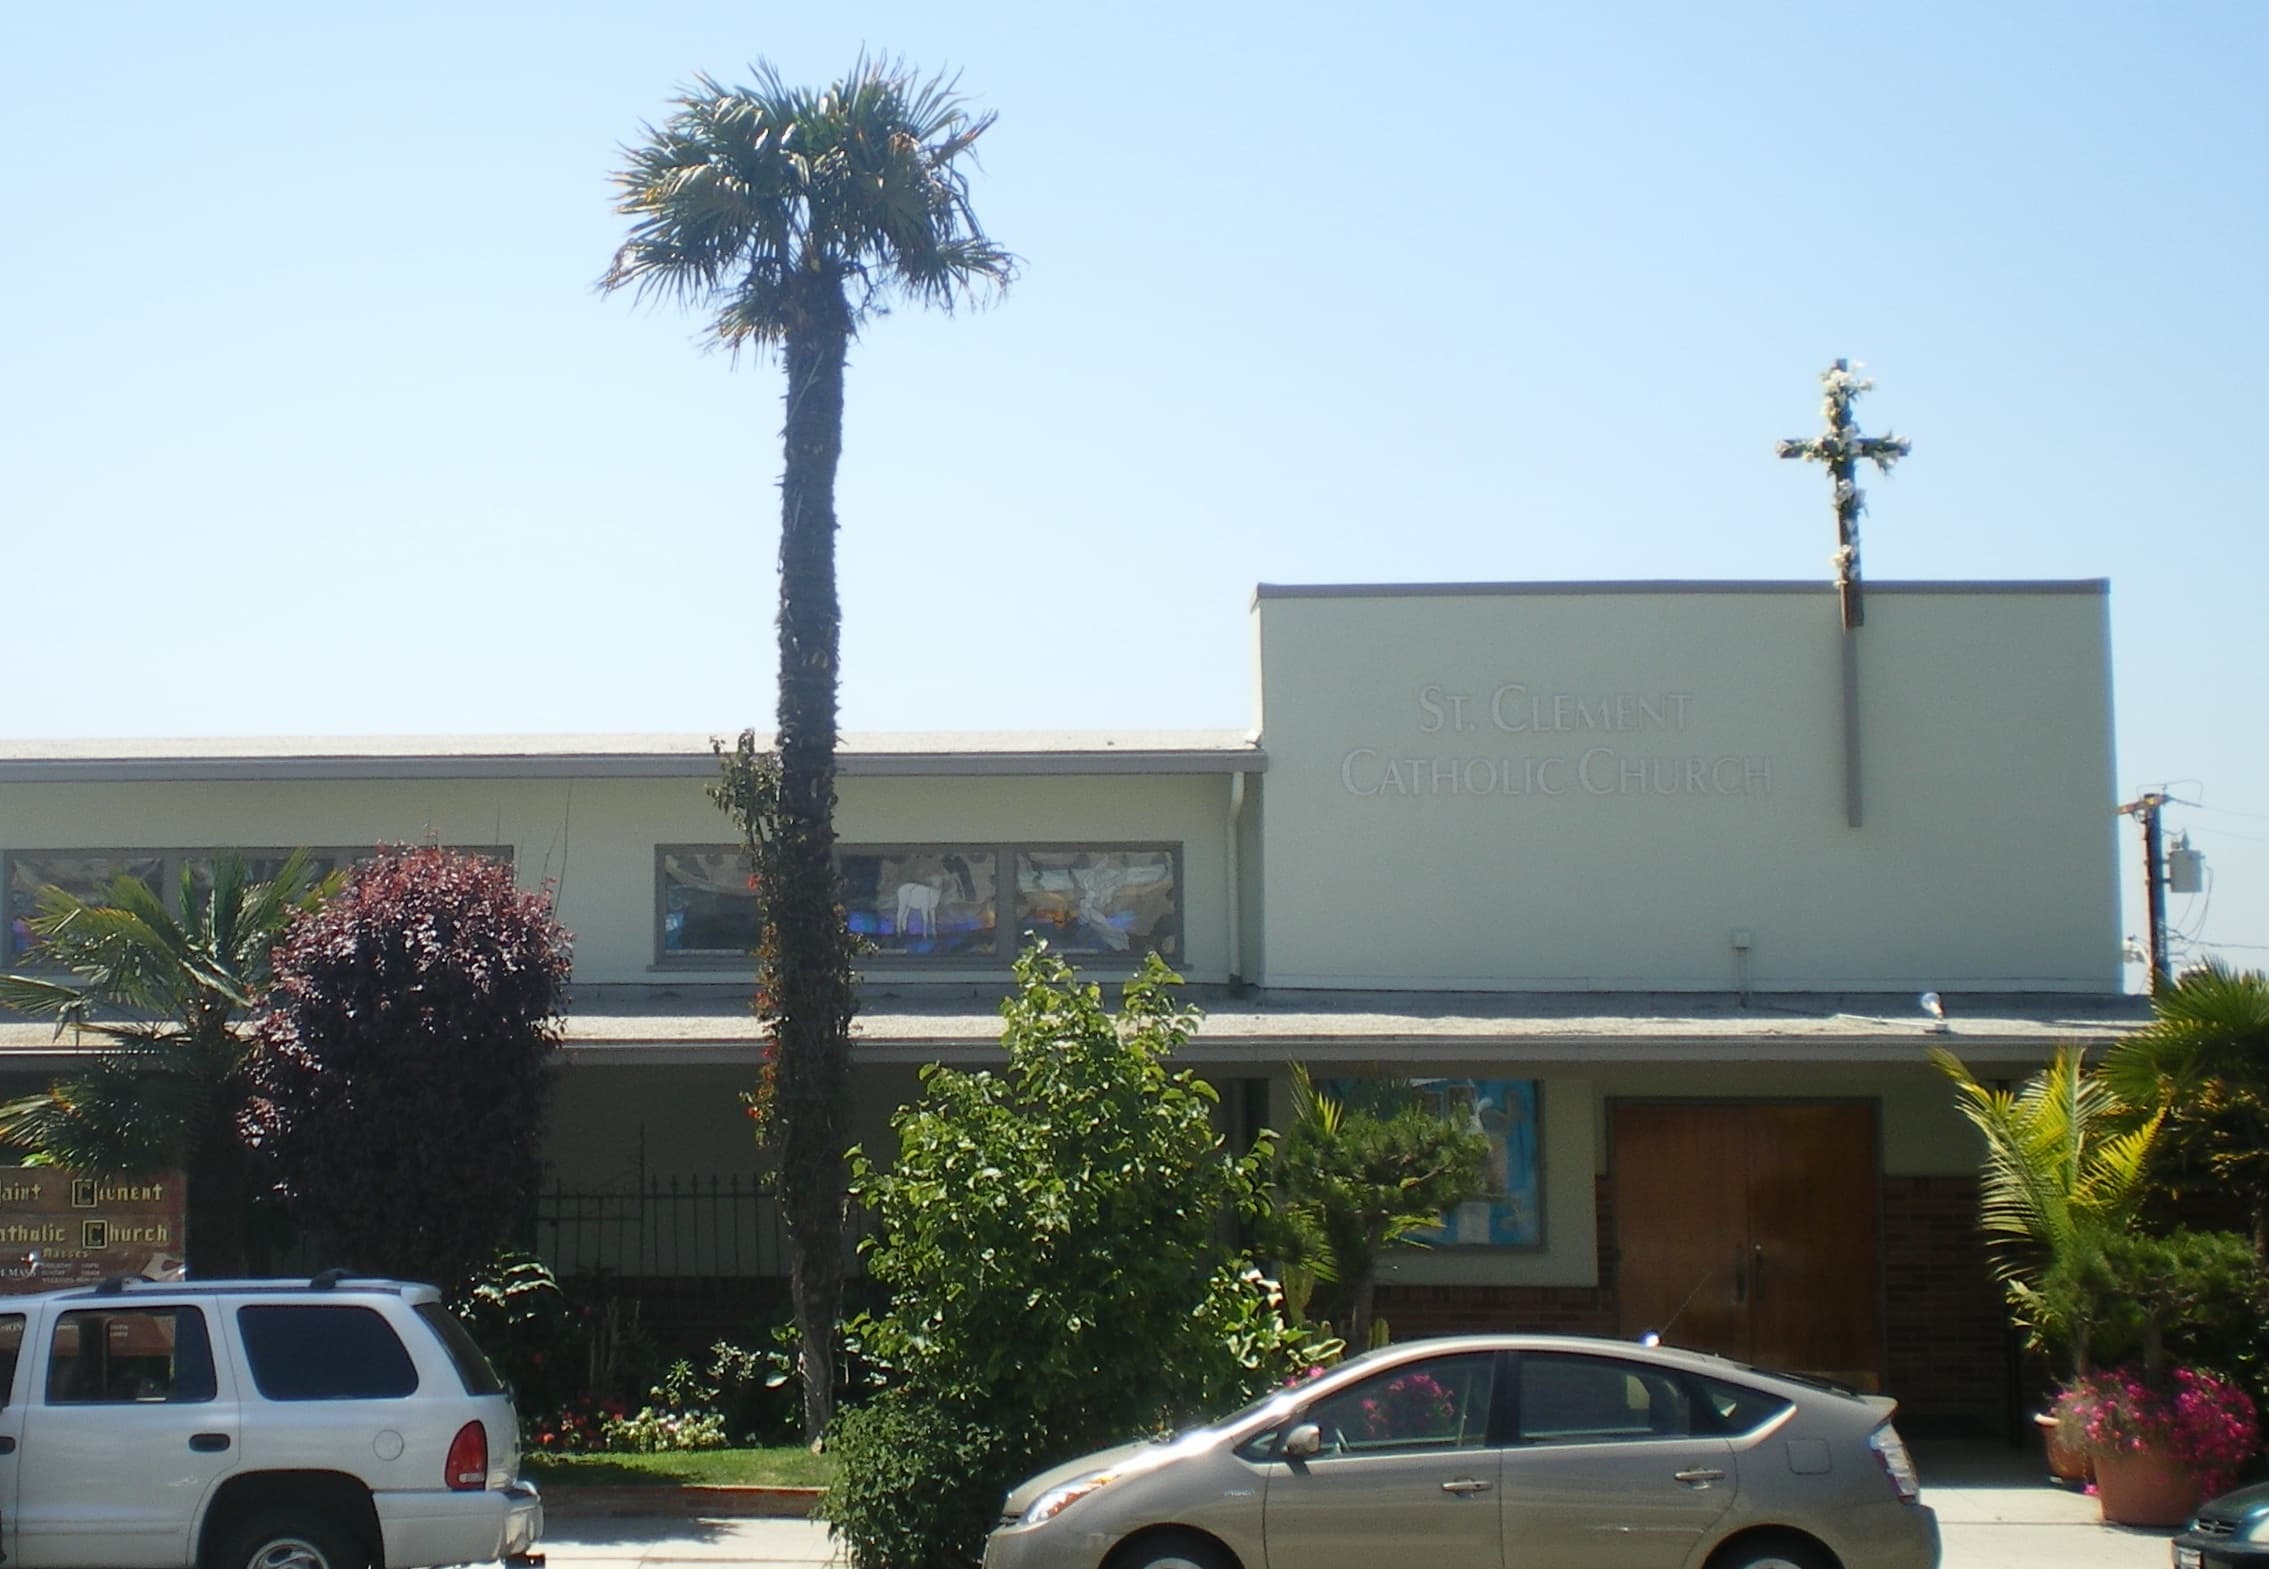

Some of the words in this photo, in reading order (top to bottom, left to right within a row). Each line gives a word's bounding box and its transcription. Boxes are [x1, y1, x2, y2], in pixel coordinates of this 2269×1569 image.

[1417, 683, 1476, 734] ST.
[1489, 681, 1694, 733] CLEMENT
[1340, 746, 1568, 797] CATHOLIC
[1576, 745, 1774, 796] CHURCH
[0, 1181, 41, 1201] aint
[0, 1223, 65, 1242] atholic
[82, 1219, 168, 1249] Church
